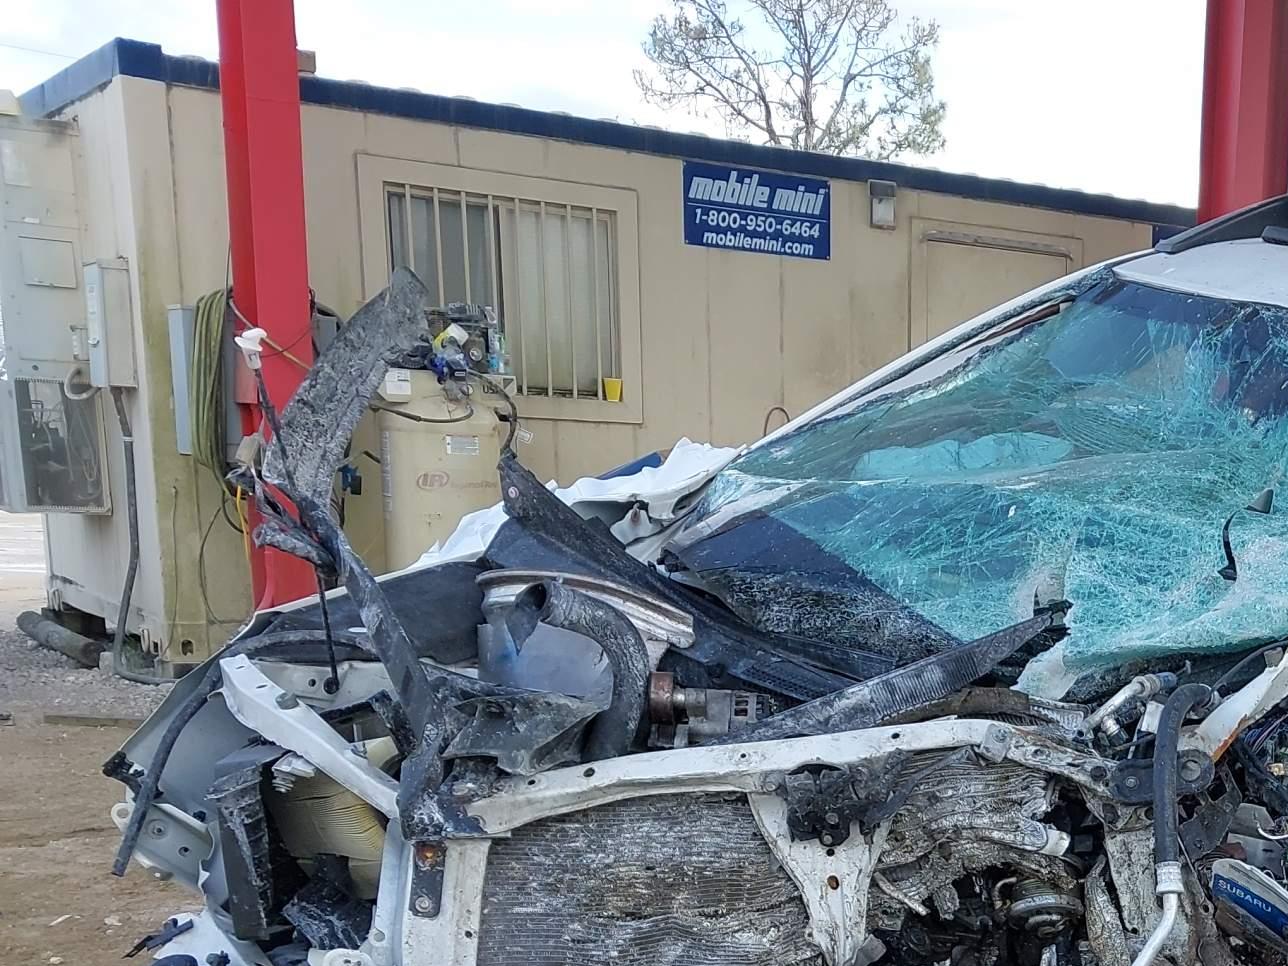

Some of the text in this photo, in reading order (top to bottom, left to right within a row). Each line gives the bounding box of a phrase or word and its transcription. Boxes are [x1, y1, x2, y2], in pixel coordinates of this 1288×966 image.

[688, 170, 826, 215] mobile mini
[695, 208, 820, 238] 1-800-950-6464
[702, 231, 814, 256] mobilemini.com
[1217, 879, 1272, 913] SUBARU
